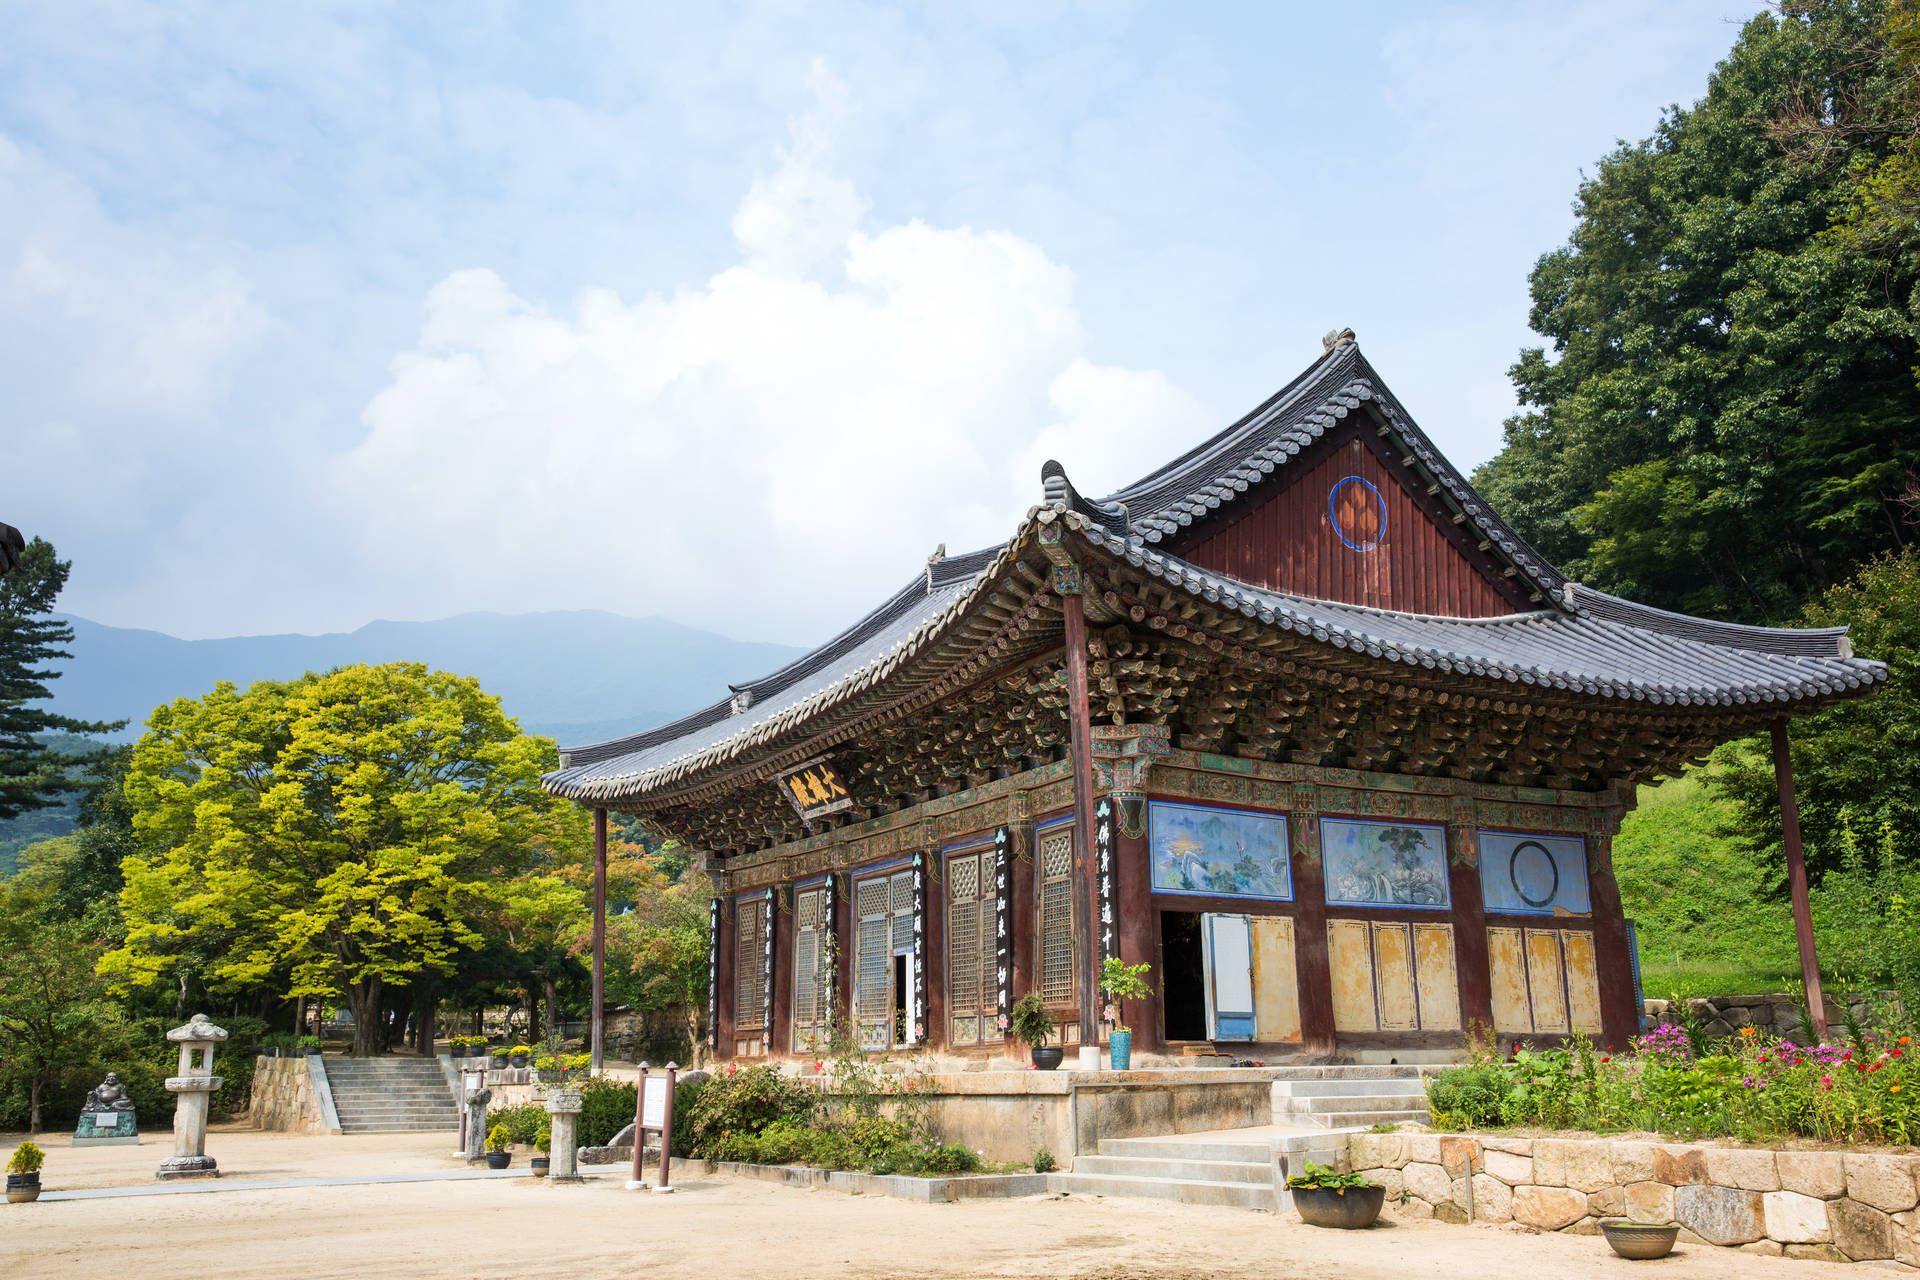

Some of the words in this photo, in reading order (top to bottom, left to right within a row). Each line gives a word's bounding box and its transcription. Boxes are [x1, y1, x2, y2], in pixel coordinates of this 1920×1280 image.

[1099, 820, 1113, 1001] 佛身普遍十
